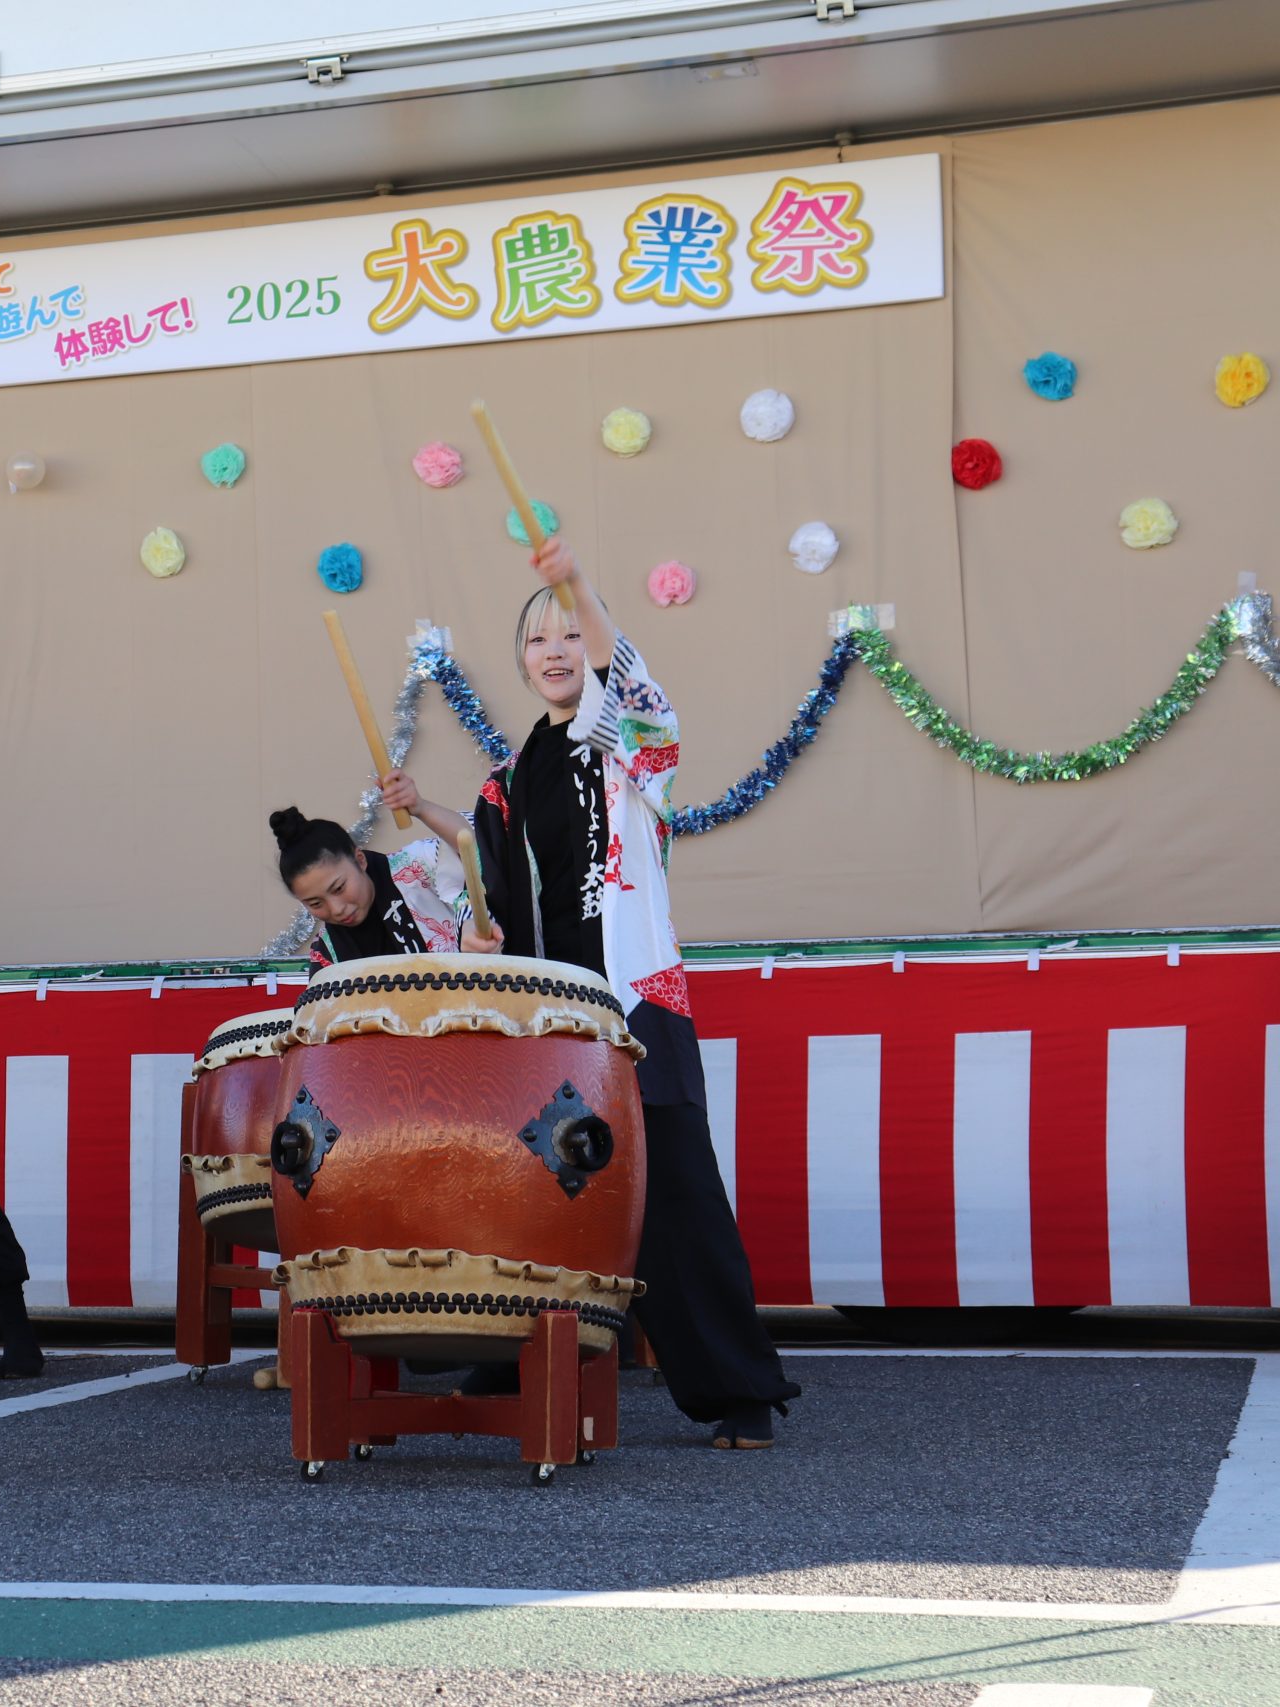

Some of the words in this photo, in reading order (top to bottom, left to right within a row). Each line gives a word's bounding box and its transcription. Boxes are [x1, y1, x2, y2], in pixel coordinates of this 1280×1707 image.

[227, 275, 341, 324] 2025
[368, 180, 868, 331] 大農業祭
[54, 297, 194, 366] 体験して!
